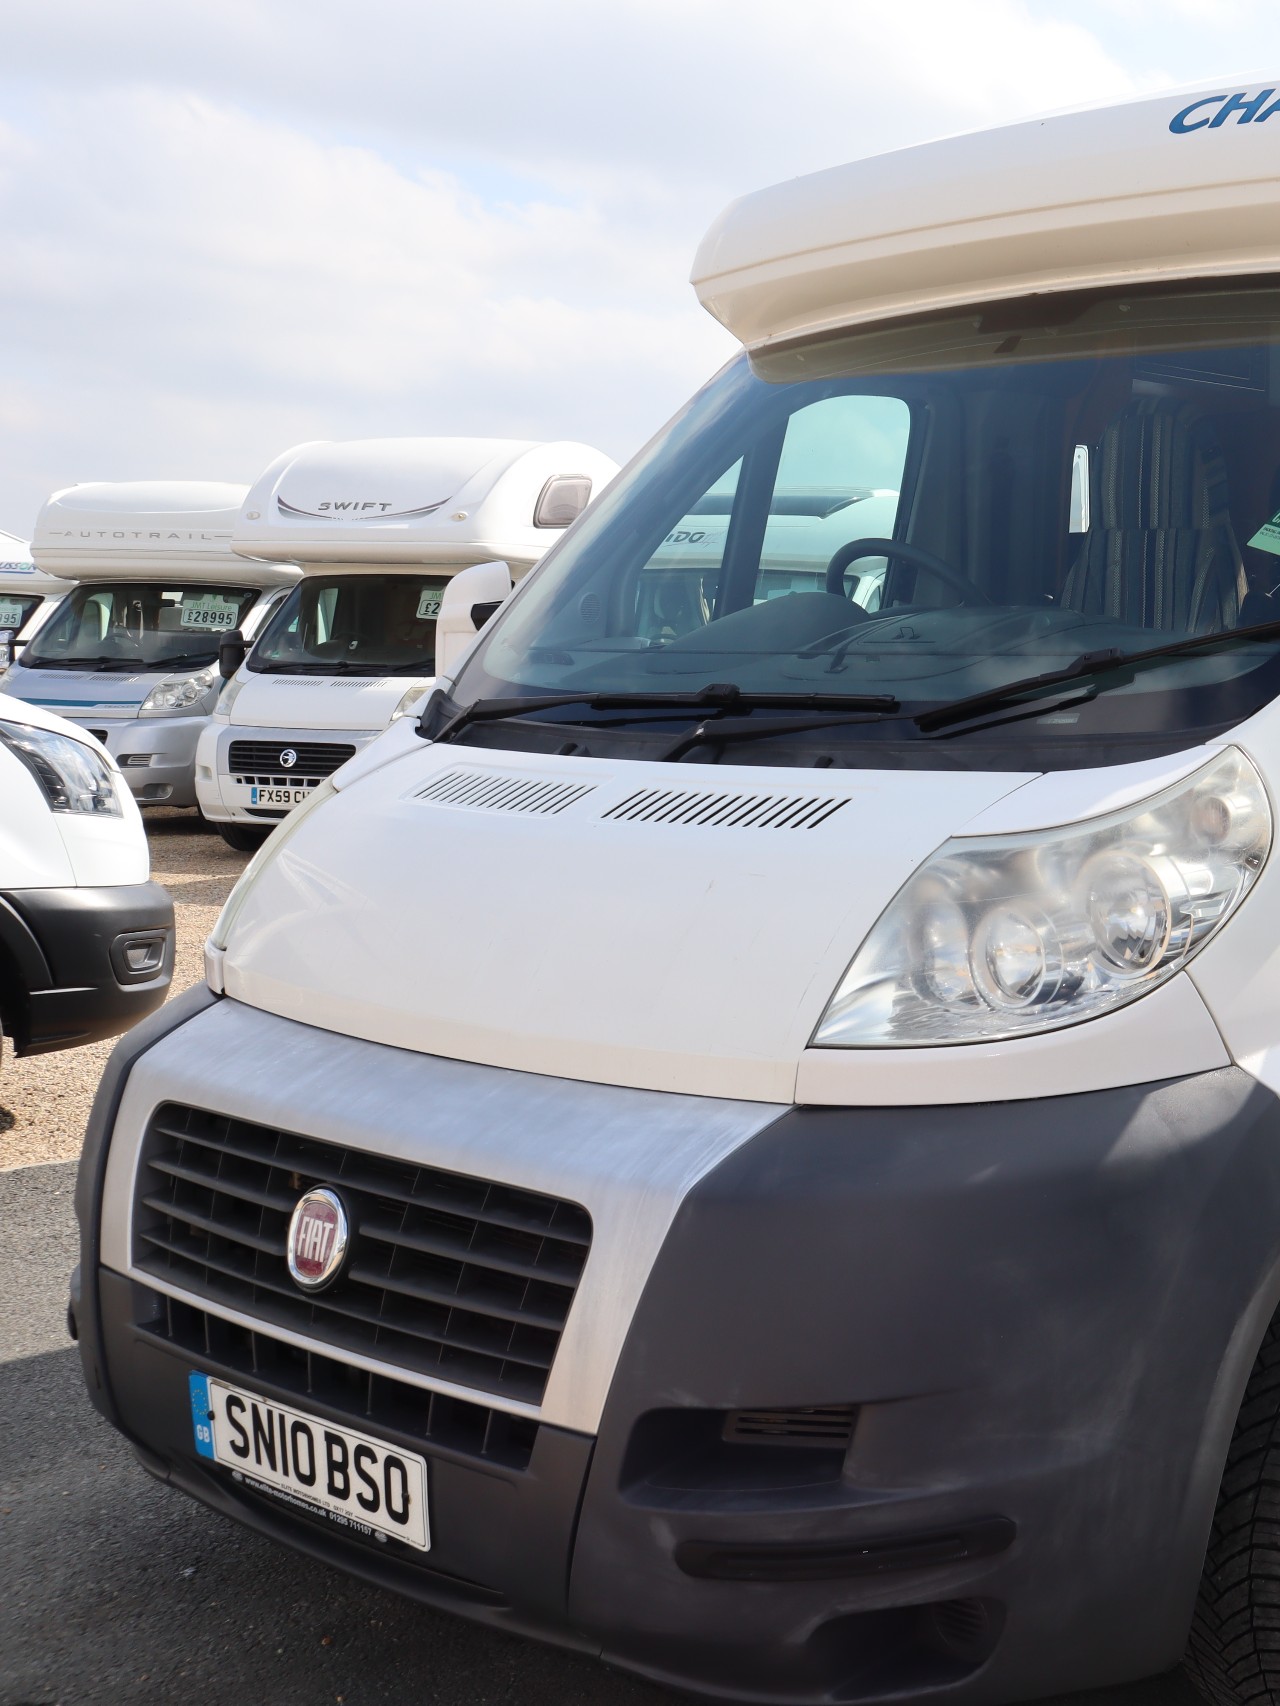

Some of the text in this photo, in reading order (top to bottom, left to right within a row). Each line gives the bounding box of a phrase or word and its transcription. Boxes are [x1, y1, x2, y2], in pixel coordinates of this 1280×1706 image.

[318, 502, 392, 512] SWIFT
[64, 531, 212, 541] AUTOTRAIL
[207, 602, 232, 611] Leisure
[188, 611, 233, 625] £28995
[259, 789, 290, 803] FX59
[298, 1215, 334, 1263] FIAT
[197, 1424, 210, 1443] GB
[225, 1394, 410, 1526] SN10 BSO
